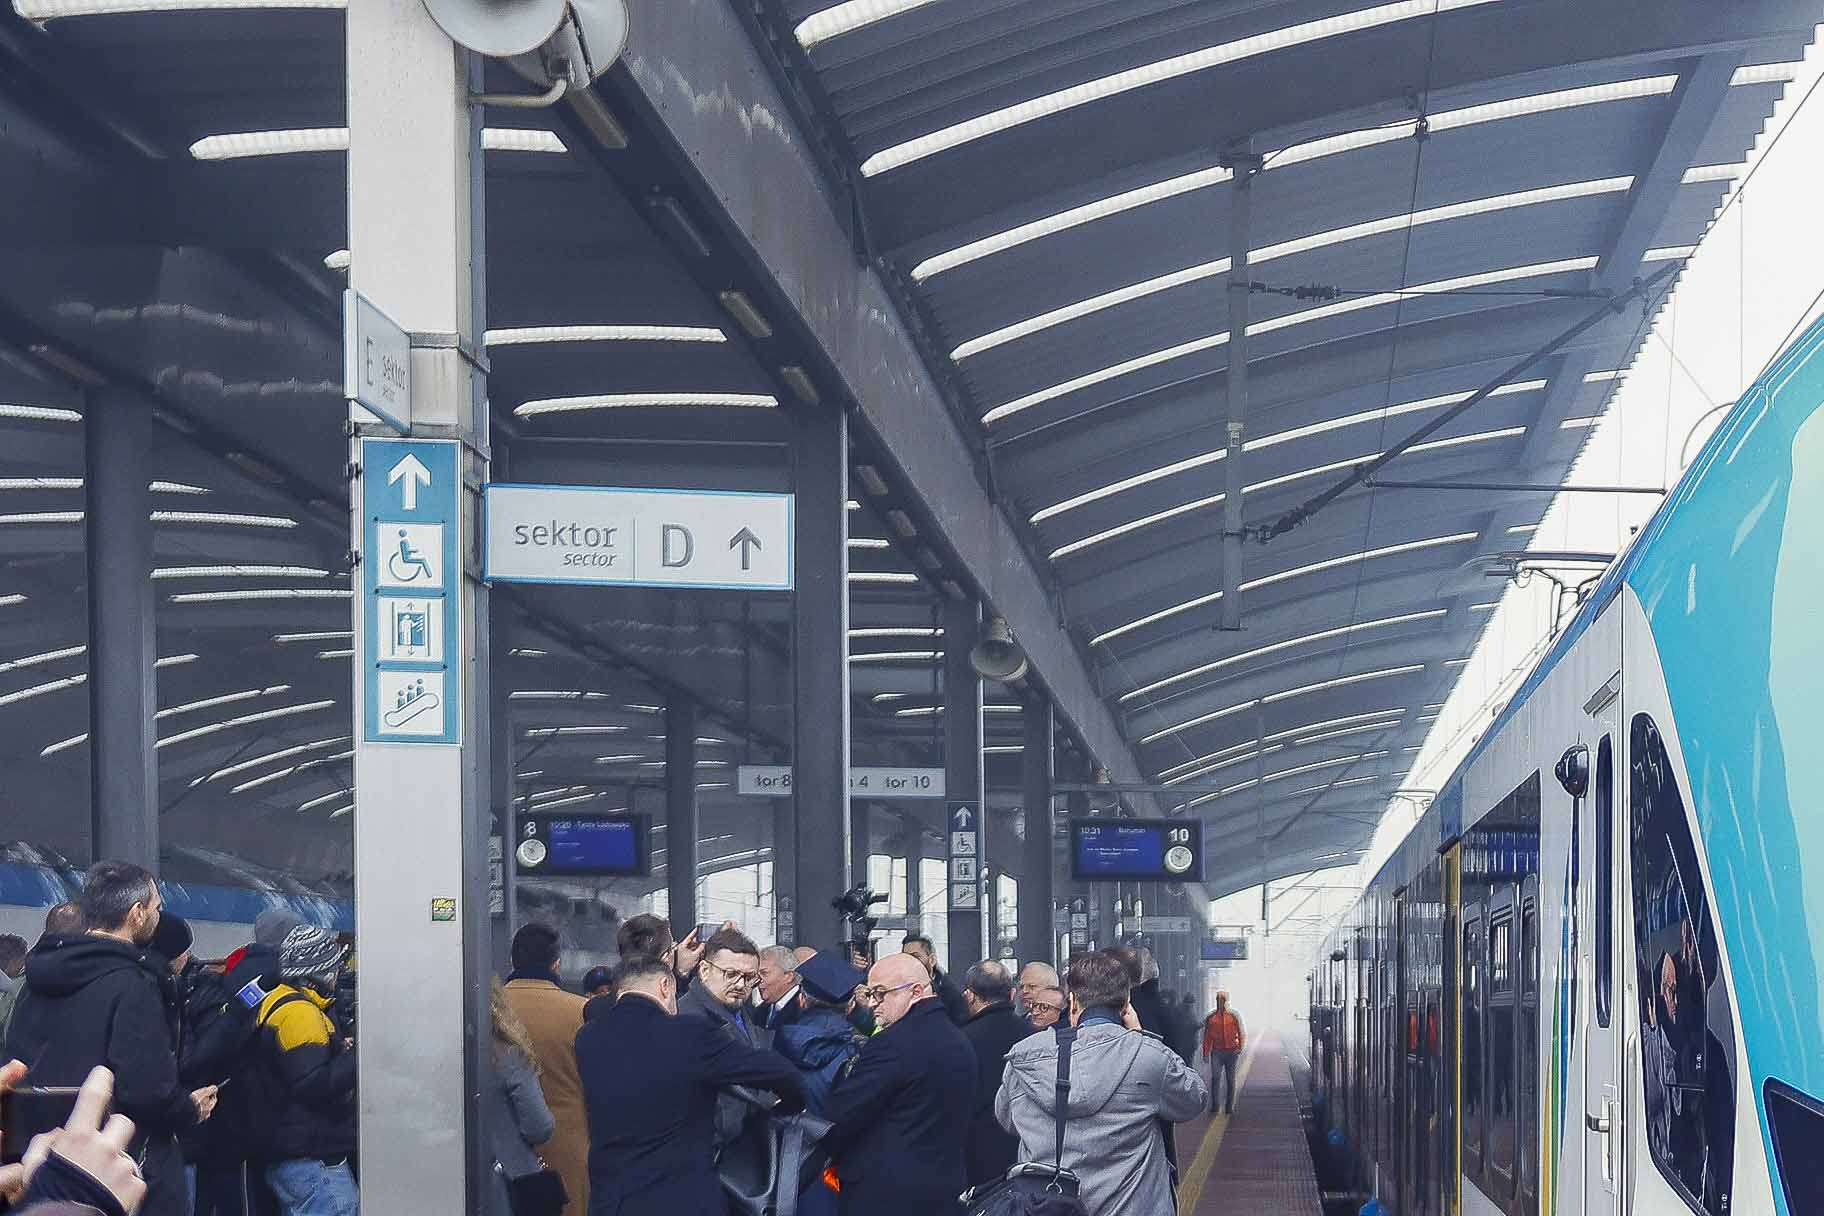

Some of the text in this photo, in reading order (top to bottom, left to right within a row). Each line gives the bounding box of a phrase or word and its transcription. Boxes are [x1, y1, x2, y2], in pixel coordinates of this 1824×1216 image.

[514, 518, 618, 548] sektor
[661, 523, 695, 568] D
[562, 551, 617, 568] sector
[757, 774, 779, 786] tor
[781, 774, 792, 787] 8
[886, 775, 908, 788] tor
[913, 775, 931, 789] 10
[524, 821, 537, 835] 8
[1168, 827, 1190, 842] 10
